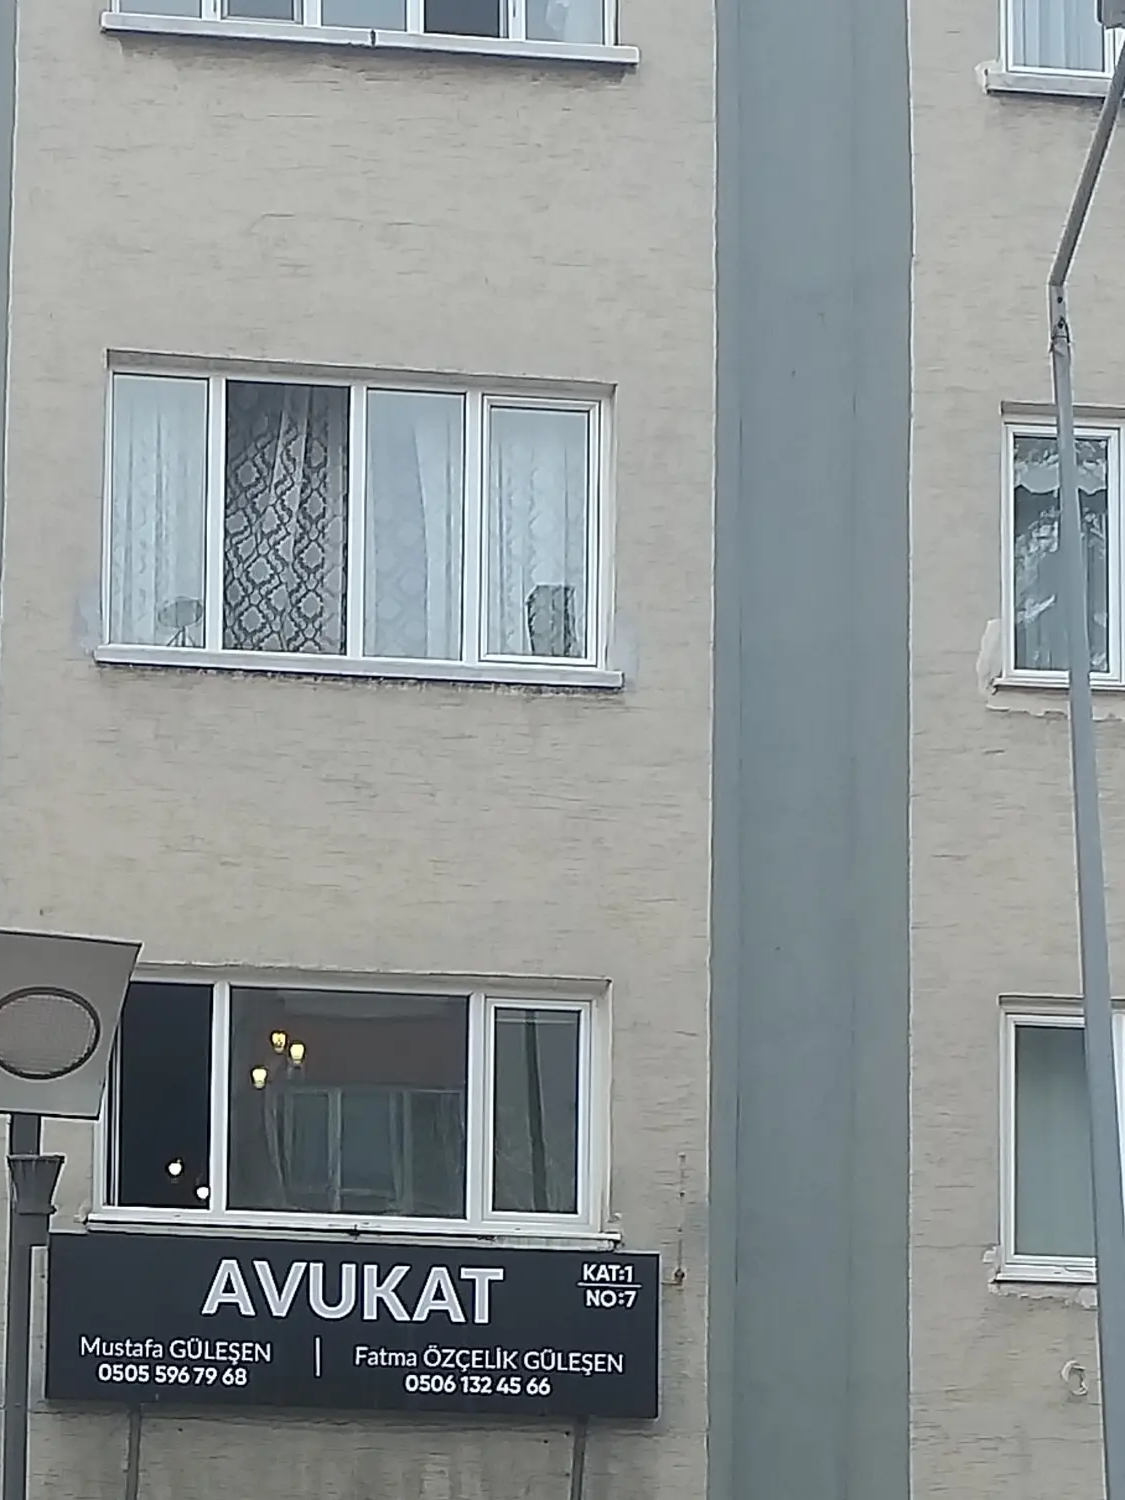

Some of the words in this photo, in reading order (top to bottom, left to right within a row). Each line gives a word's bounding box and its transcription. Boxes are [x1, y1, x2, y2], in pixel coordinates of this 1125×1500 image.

[582, 1263, 634, 1283] KAT:1
[201, 1259, 504, 1324] AVUKAT
[585, 1288, 637, 1309] NO:7
[80, 1336, 164, 1360] Mustafa
[170, 1337, 272, 1366] GÜLEŞEN
[355, 1347, 417, 1367] Fatma
[423, 1345, 517, 1375] ÖZÇELİK
[523, 1348, 624, 1378] GÜLEŞEN
[98, 1365, 150, 1384] 0505
[155, 1366, 191, 1386] 596
[192, 1367, 218, 1386] 79
[221, 1367, 248, 1387] 68
[405, 1375, 456, 1394] 0506
[459, 1376, 493, 1395] 132
[495, 1377, 522, 1396] 45
[524, 1377, 551, 1396] 66
